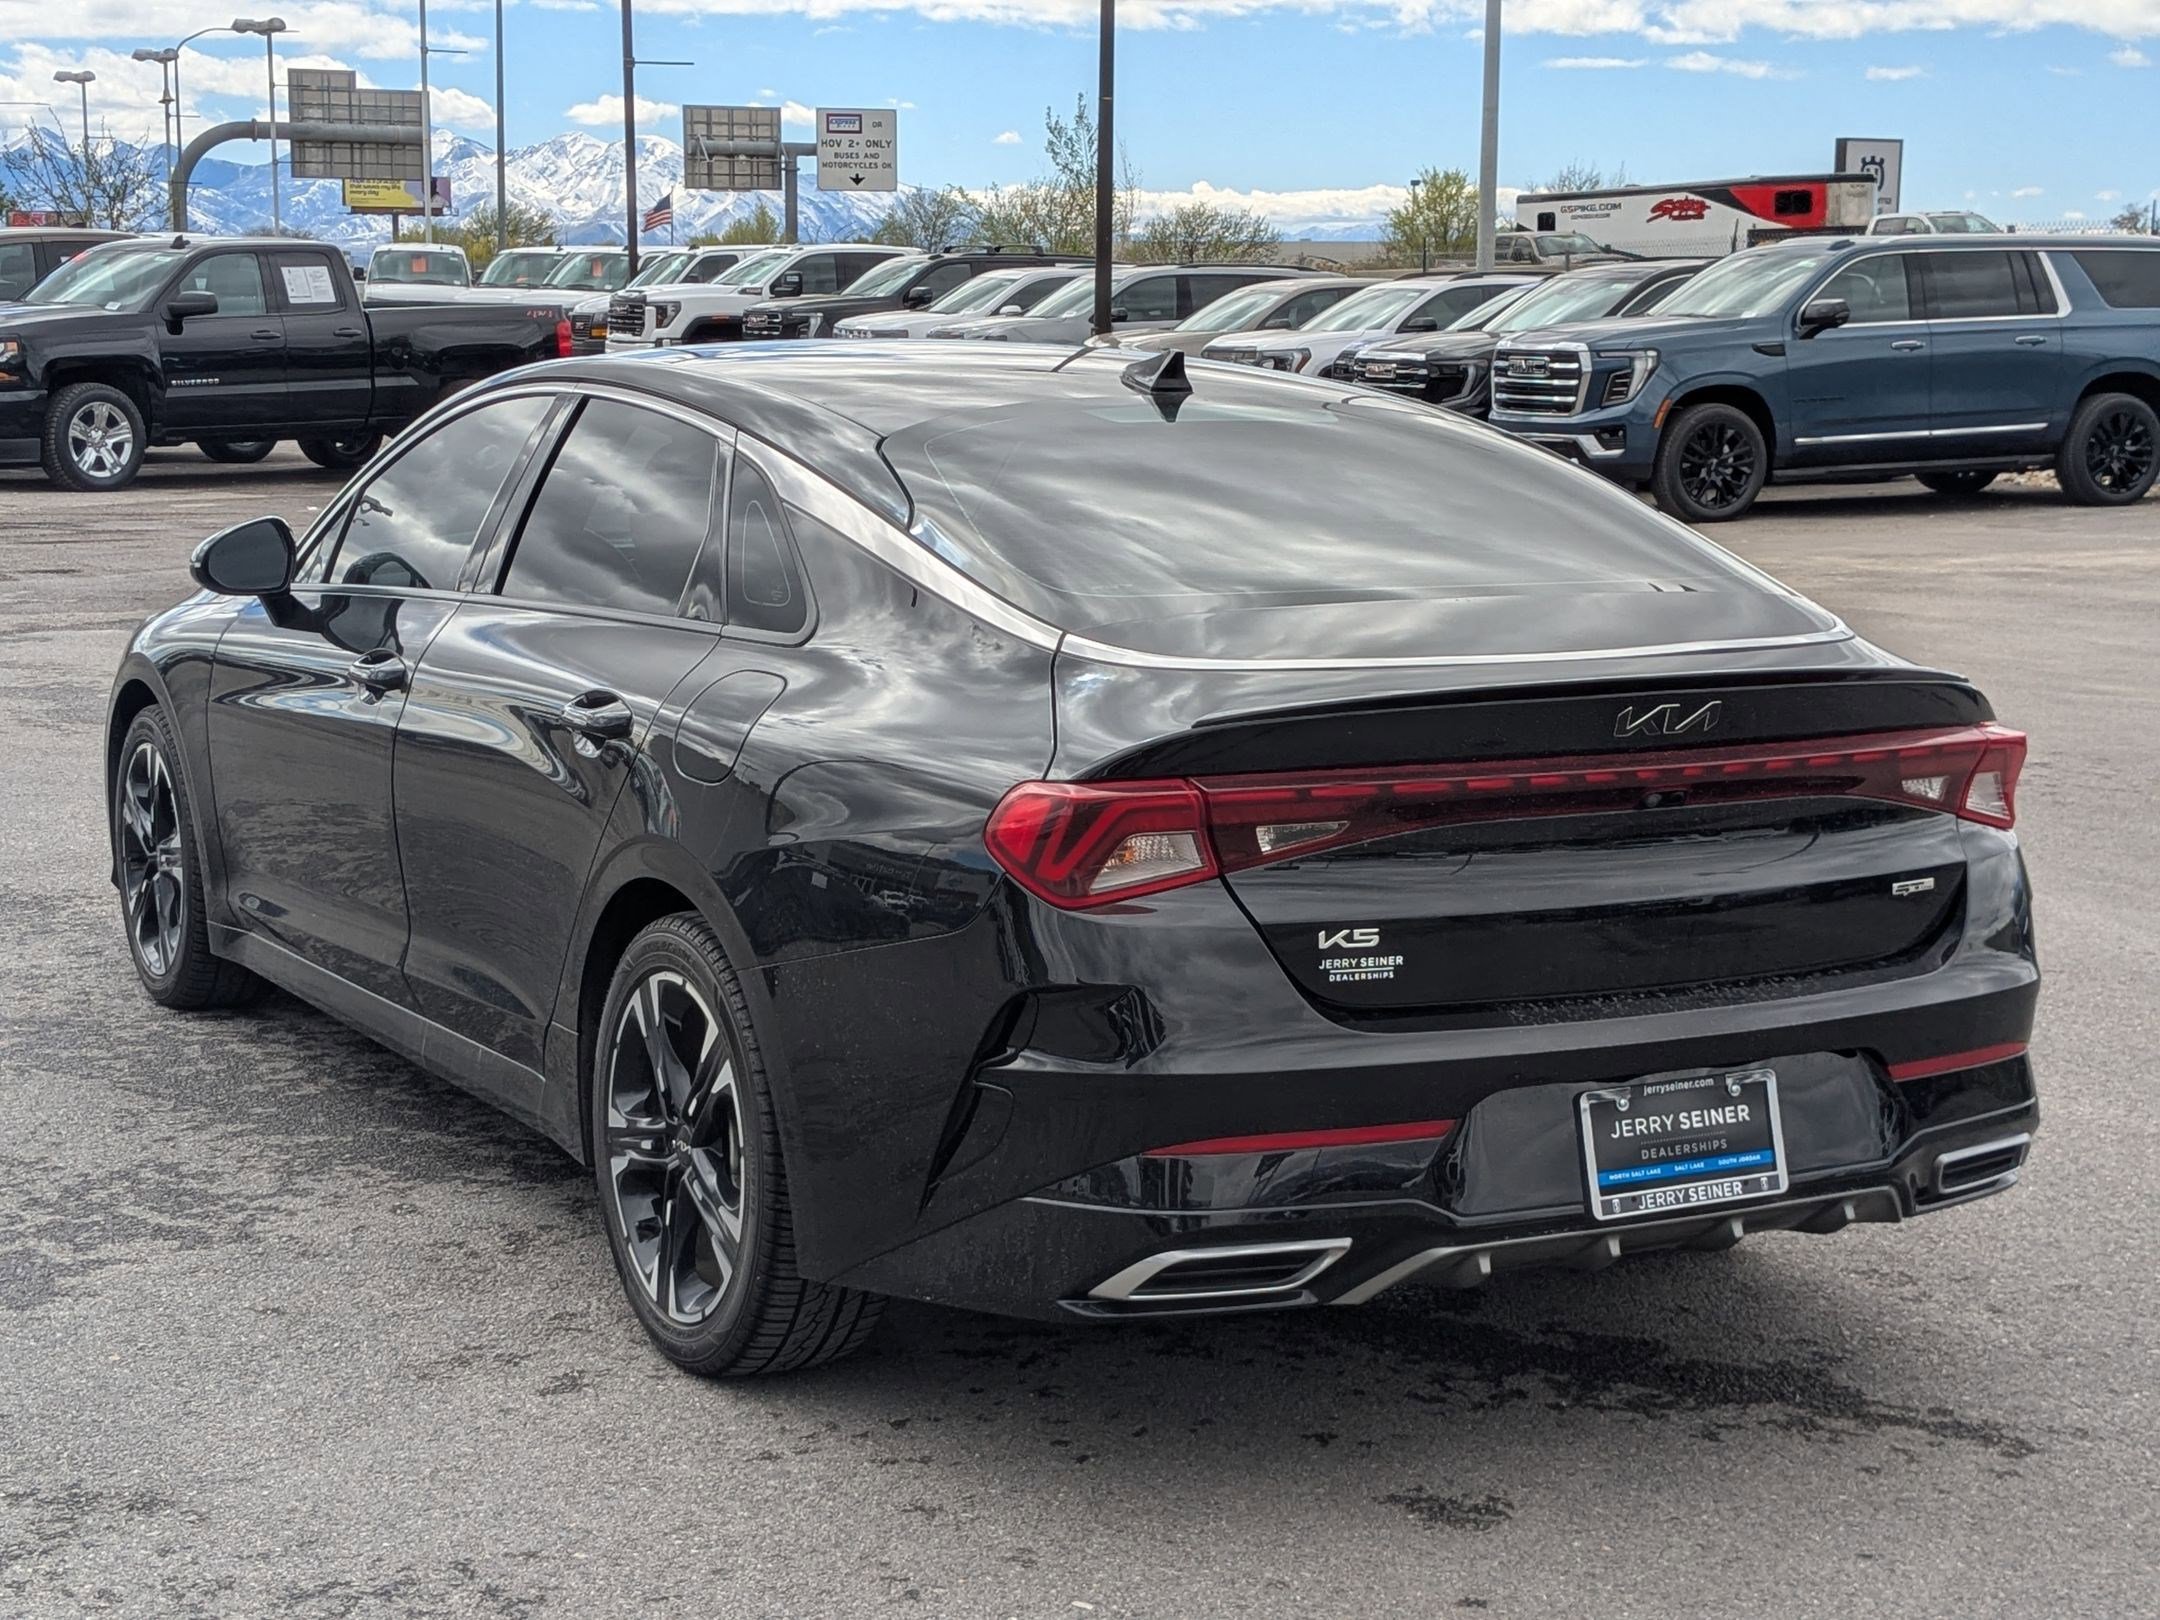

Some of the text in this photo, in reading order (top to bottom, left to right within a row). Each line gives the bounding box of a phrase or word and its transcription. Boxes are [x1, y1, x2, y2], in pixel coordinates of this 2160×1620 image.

[821, 139, 842, 148] HOV
[865, 140, 892, 149] ONLY
[834, 152, 880, 160] BUSES AND
[822, 161, 878, 169] MOTORCYCLES
[171, 378, 220, 386] SILVERADO
[1318, 928, 1380, 949] K5
[1318, 955, 1404, 970] JERRY SEINER
[1329, 971, 1394, 982] DEALERSHIPS
[1643, 1078, 1714, 1096] jerryseiner.com
[1610, 1104, 1750, 1139] JERRY SEINER
[1641, 1139, 1728, 1160] DEALERSHIPS
[1638, 1189, 1686, 1210] JERRY
[1688, 1181, 1743, 1201] SEINER
